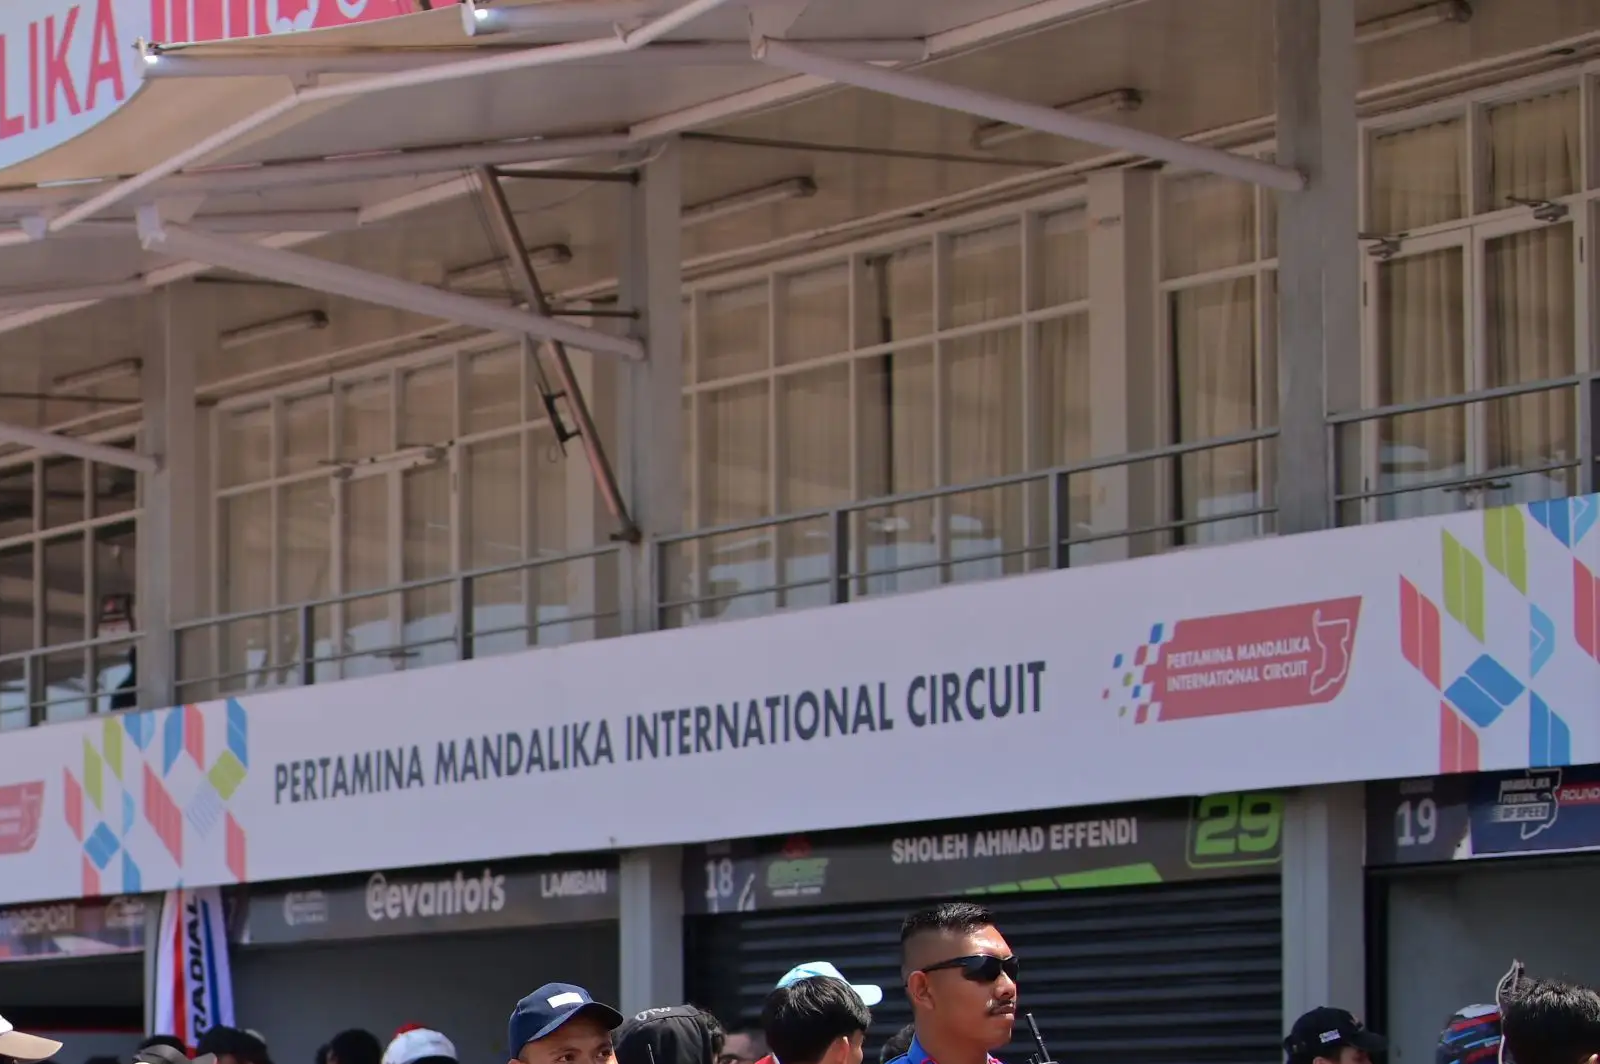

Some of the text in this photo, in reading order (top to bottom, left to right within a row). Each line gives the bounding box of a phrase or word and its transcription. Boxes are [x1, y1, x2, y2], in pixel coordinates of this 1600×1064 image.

[1167, 637, 1311, 670] PERTAMINA MANDALIKA
[1167, 660, 1308, 692] INTERNATIONAL CIRCUIT
[275, 660, 1046, 804] PERTAMINA MANDALIKA INTERNATIONAL CIRCUIT
[892, 816, 1138, 864] SHOLEH AHMAD EFFENDI
[1195, 795, 1284, 856] 29
[1396, 798, 1437, 846] 19
[366, 868, 506, 921] @evantots
[706, 858, 733, 898] 18
[186, 896, 209, 1041] RADIAL
